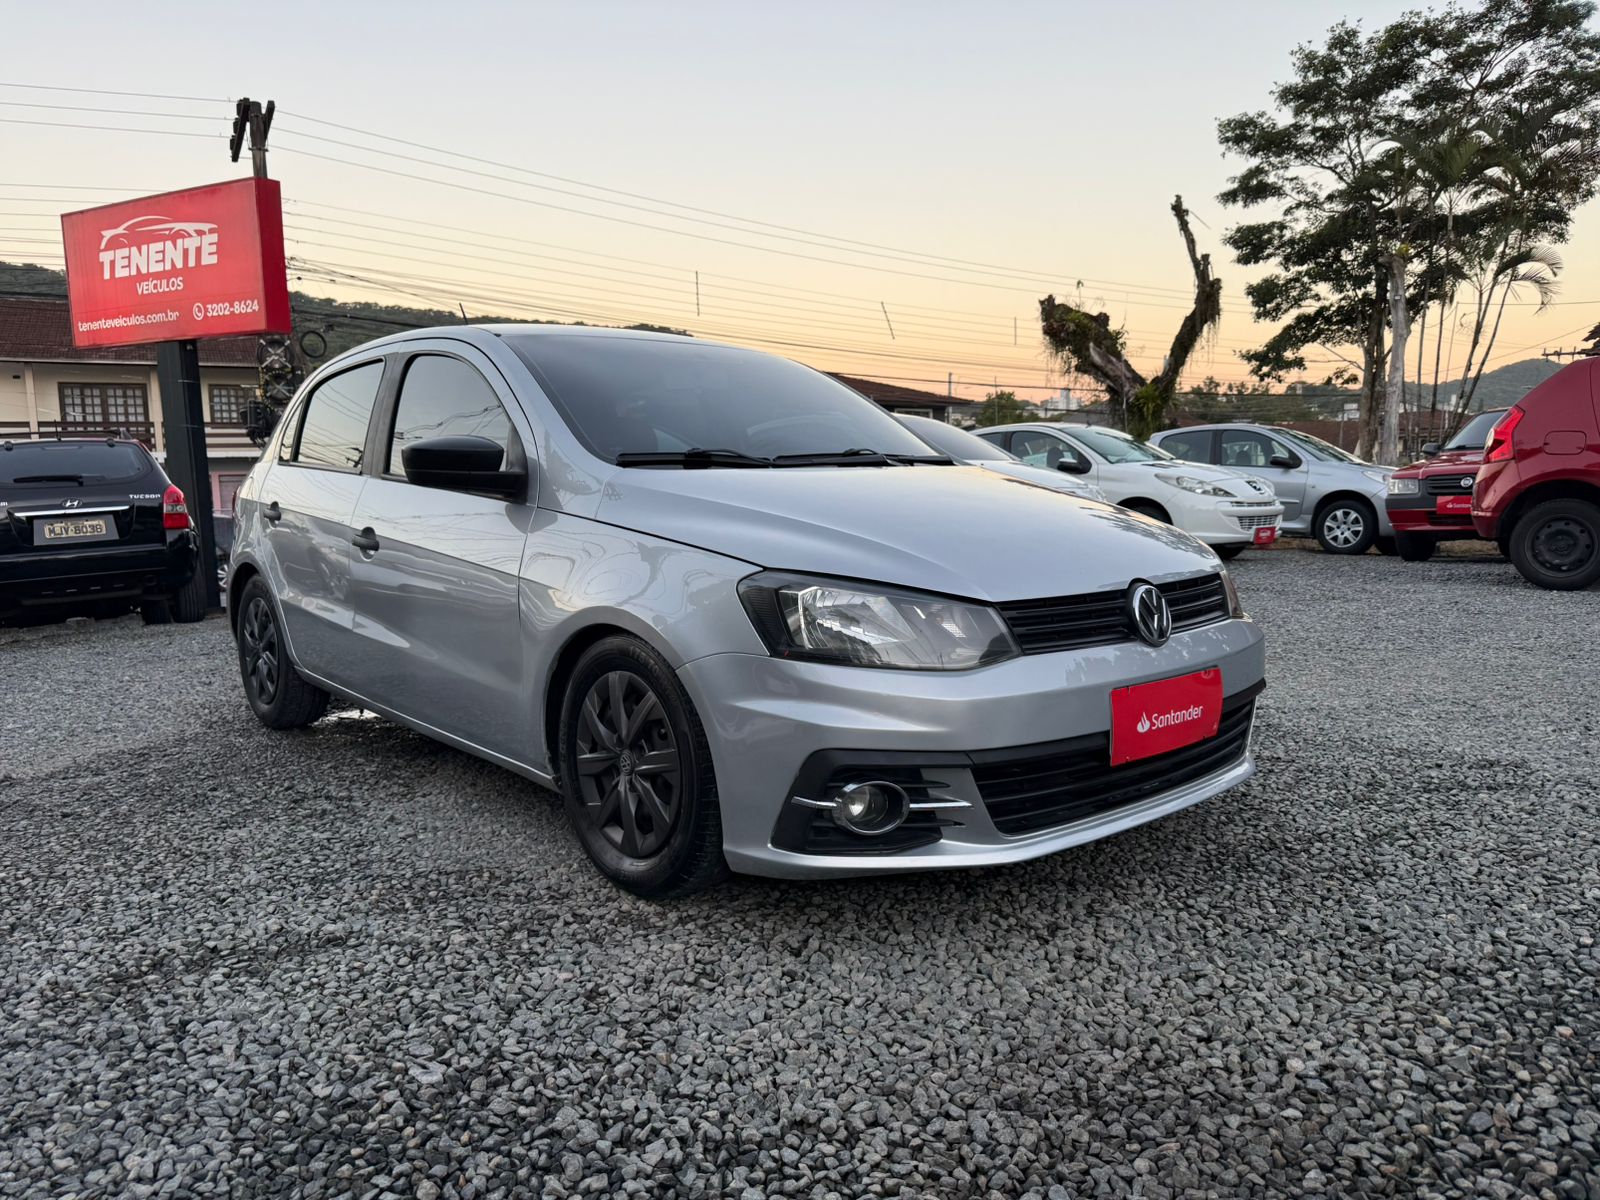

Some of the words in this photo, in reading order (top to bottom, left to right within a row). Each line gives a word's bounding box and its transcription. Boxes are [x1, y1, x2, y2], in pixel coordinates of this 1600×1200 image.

[99, 233, 218, 280] TENENTE
[136, 276, 184, 295] VEÍCULOS
[206, 300, 260, 317] 3202-8624
[78, 309, 180, 332] tenenteveiculos.com.br
[1151, 705, 1204, 730] Santander
